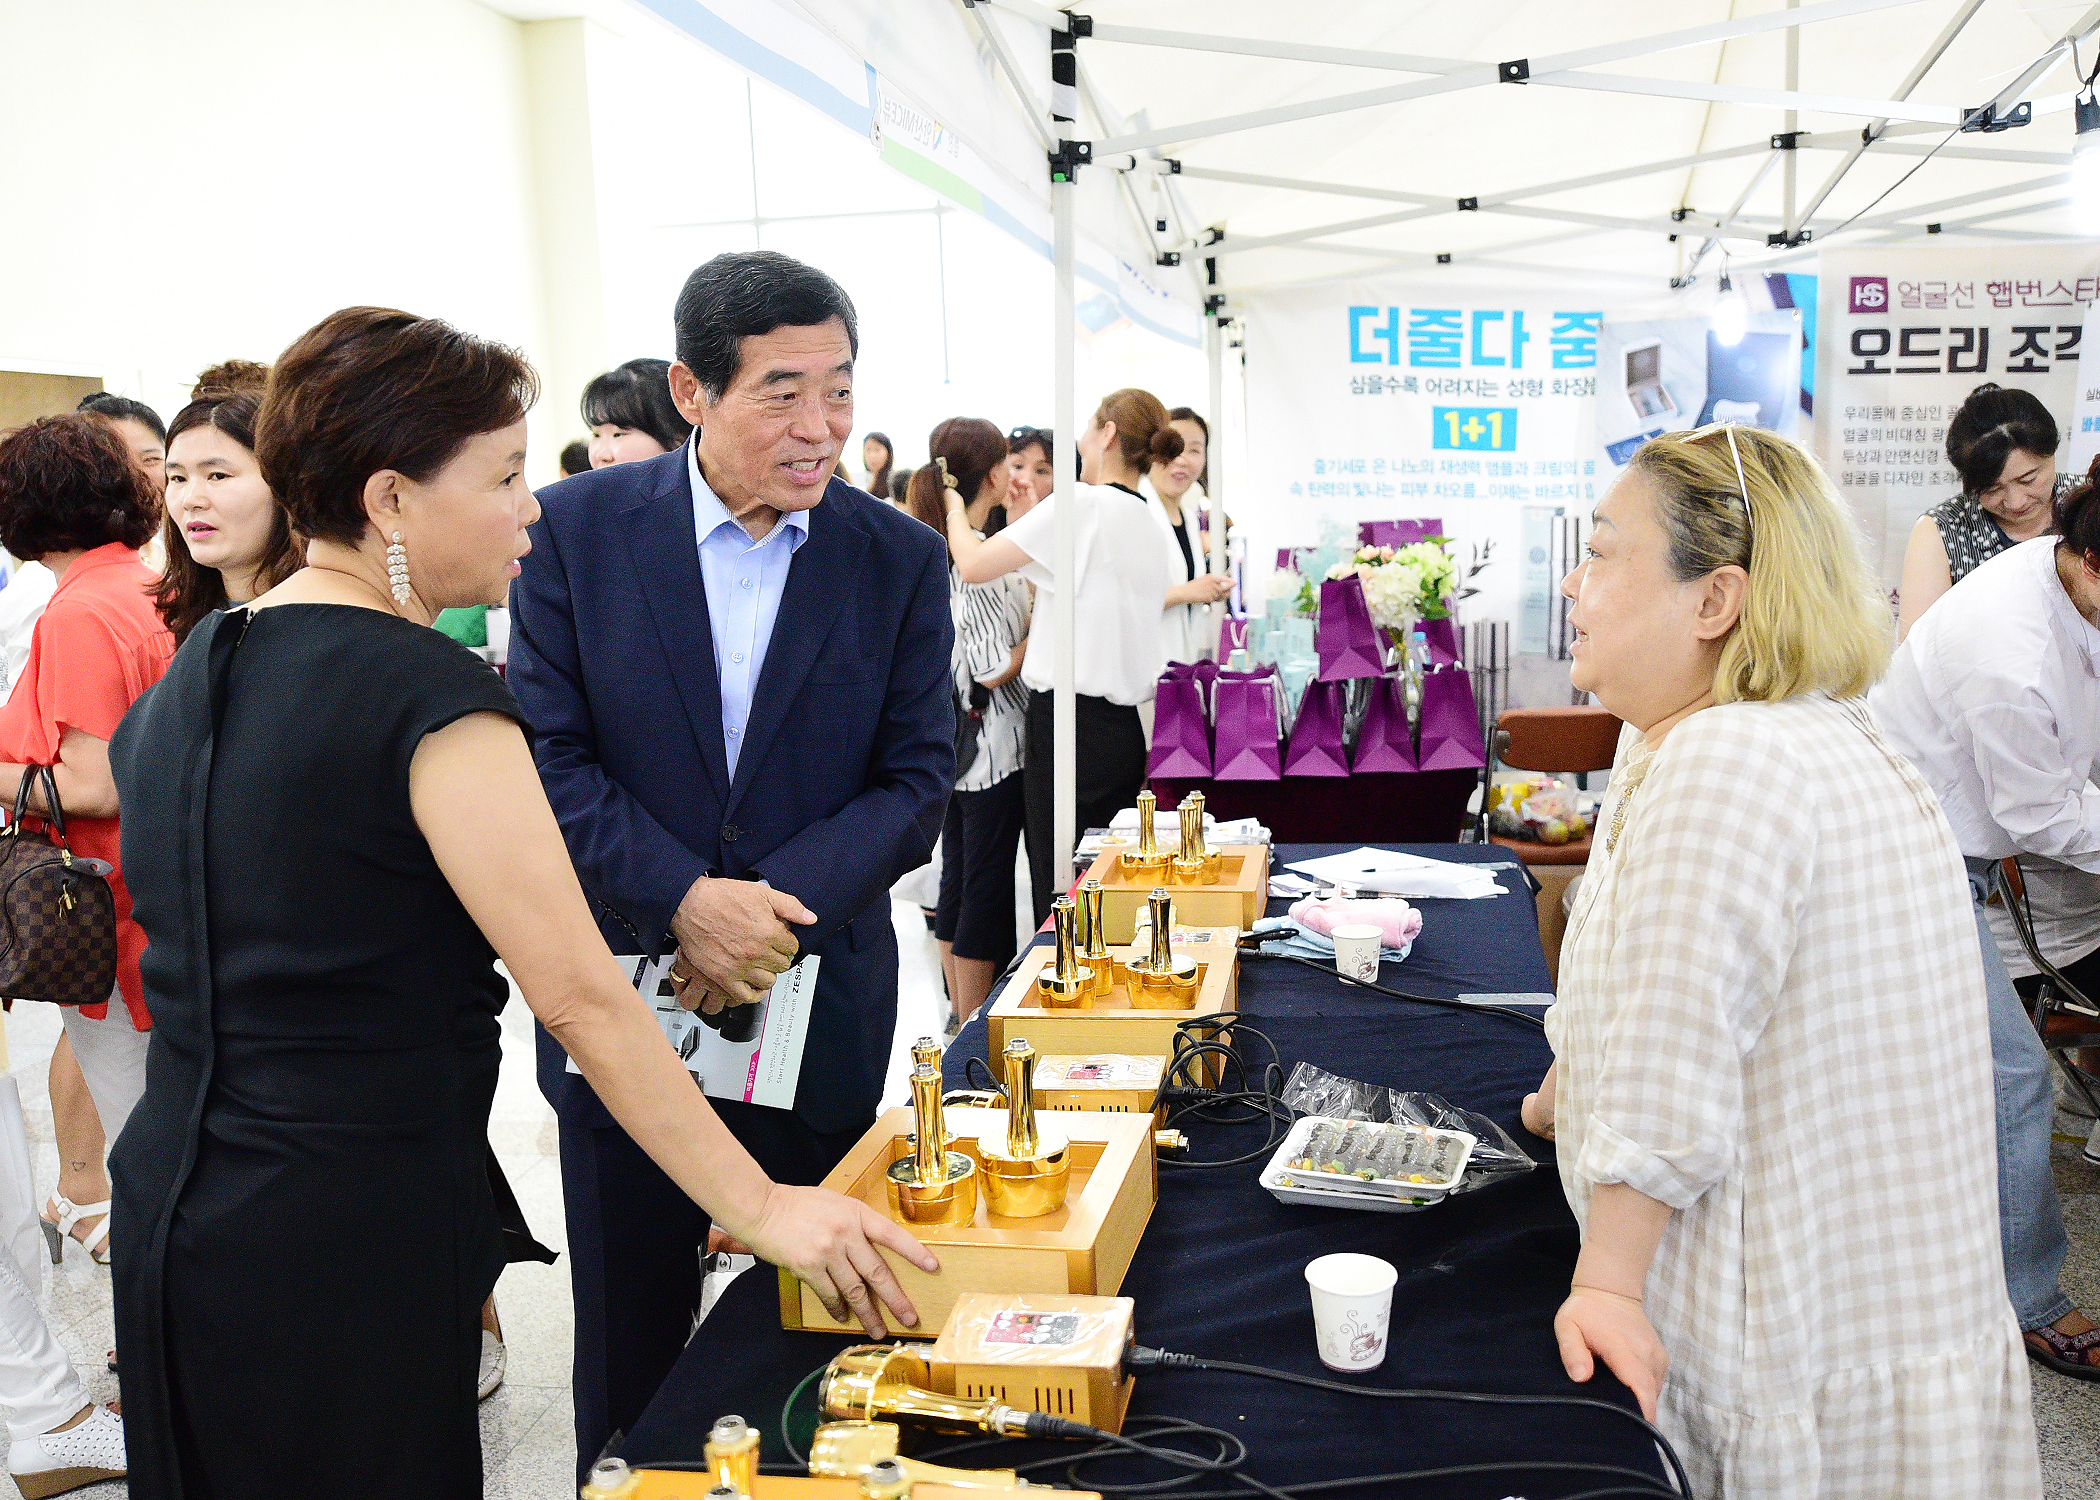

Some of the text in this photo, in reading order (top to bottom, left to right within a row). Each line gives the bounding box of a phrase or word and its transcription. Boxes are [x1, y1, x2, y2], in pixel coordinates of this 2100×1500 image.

[1897, 280, 1975, 310] 얼굴선
[1349, 306, 1530, 369] 더줄다
[1847, 326, 1990, 375] 오드리
[1350, 375, 1419, 395] 심을수록
[1425, 377, 1499, 398] 어려지는
[1506, 378, 1544, 398] 성형
[1444, 410, 1502, 449] 1+1
[1885, 427, 1927, 444] 비대칭
[1314, 457, 1367, 475] 줄기세포
[1885, 449, 1939, 466] 안면신경
[1401, 481, 1428, 498] 피부
[1884, 470, 1924, 487] 디자인
[779, 1045, 789, 1067] Health
[785, 1012, 796, 1037] Beauty
[792, 961, 805, 994] ZESPA
